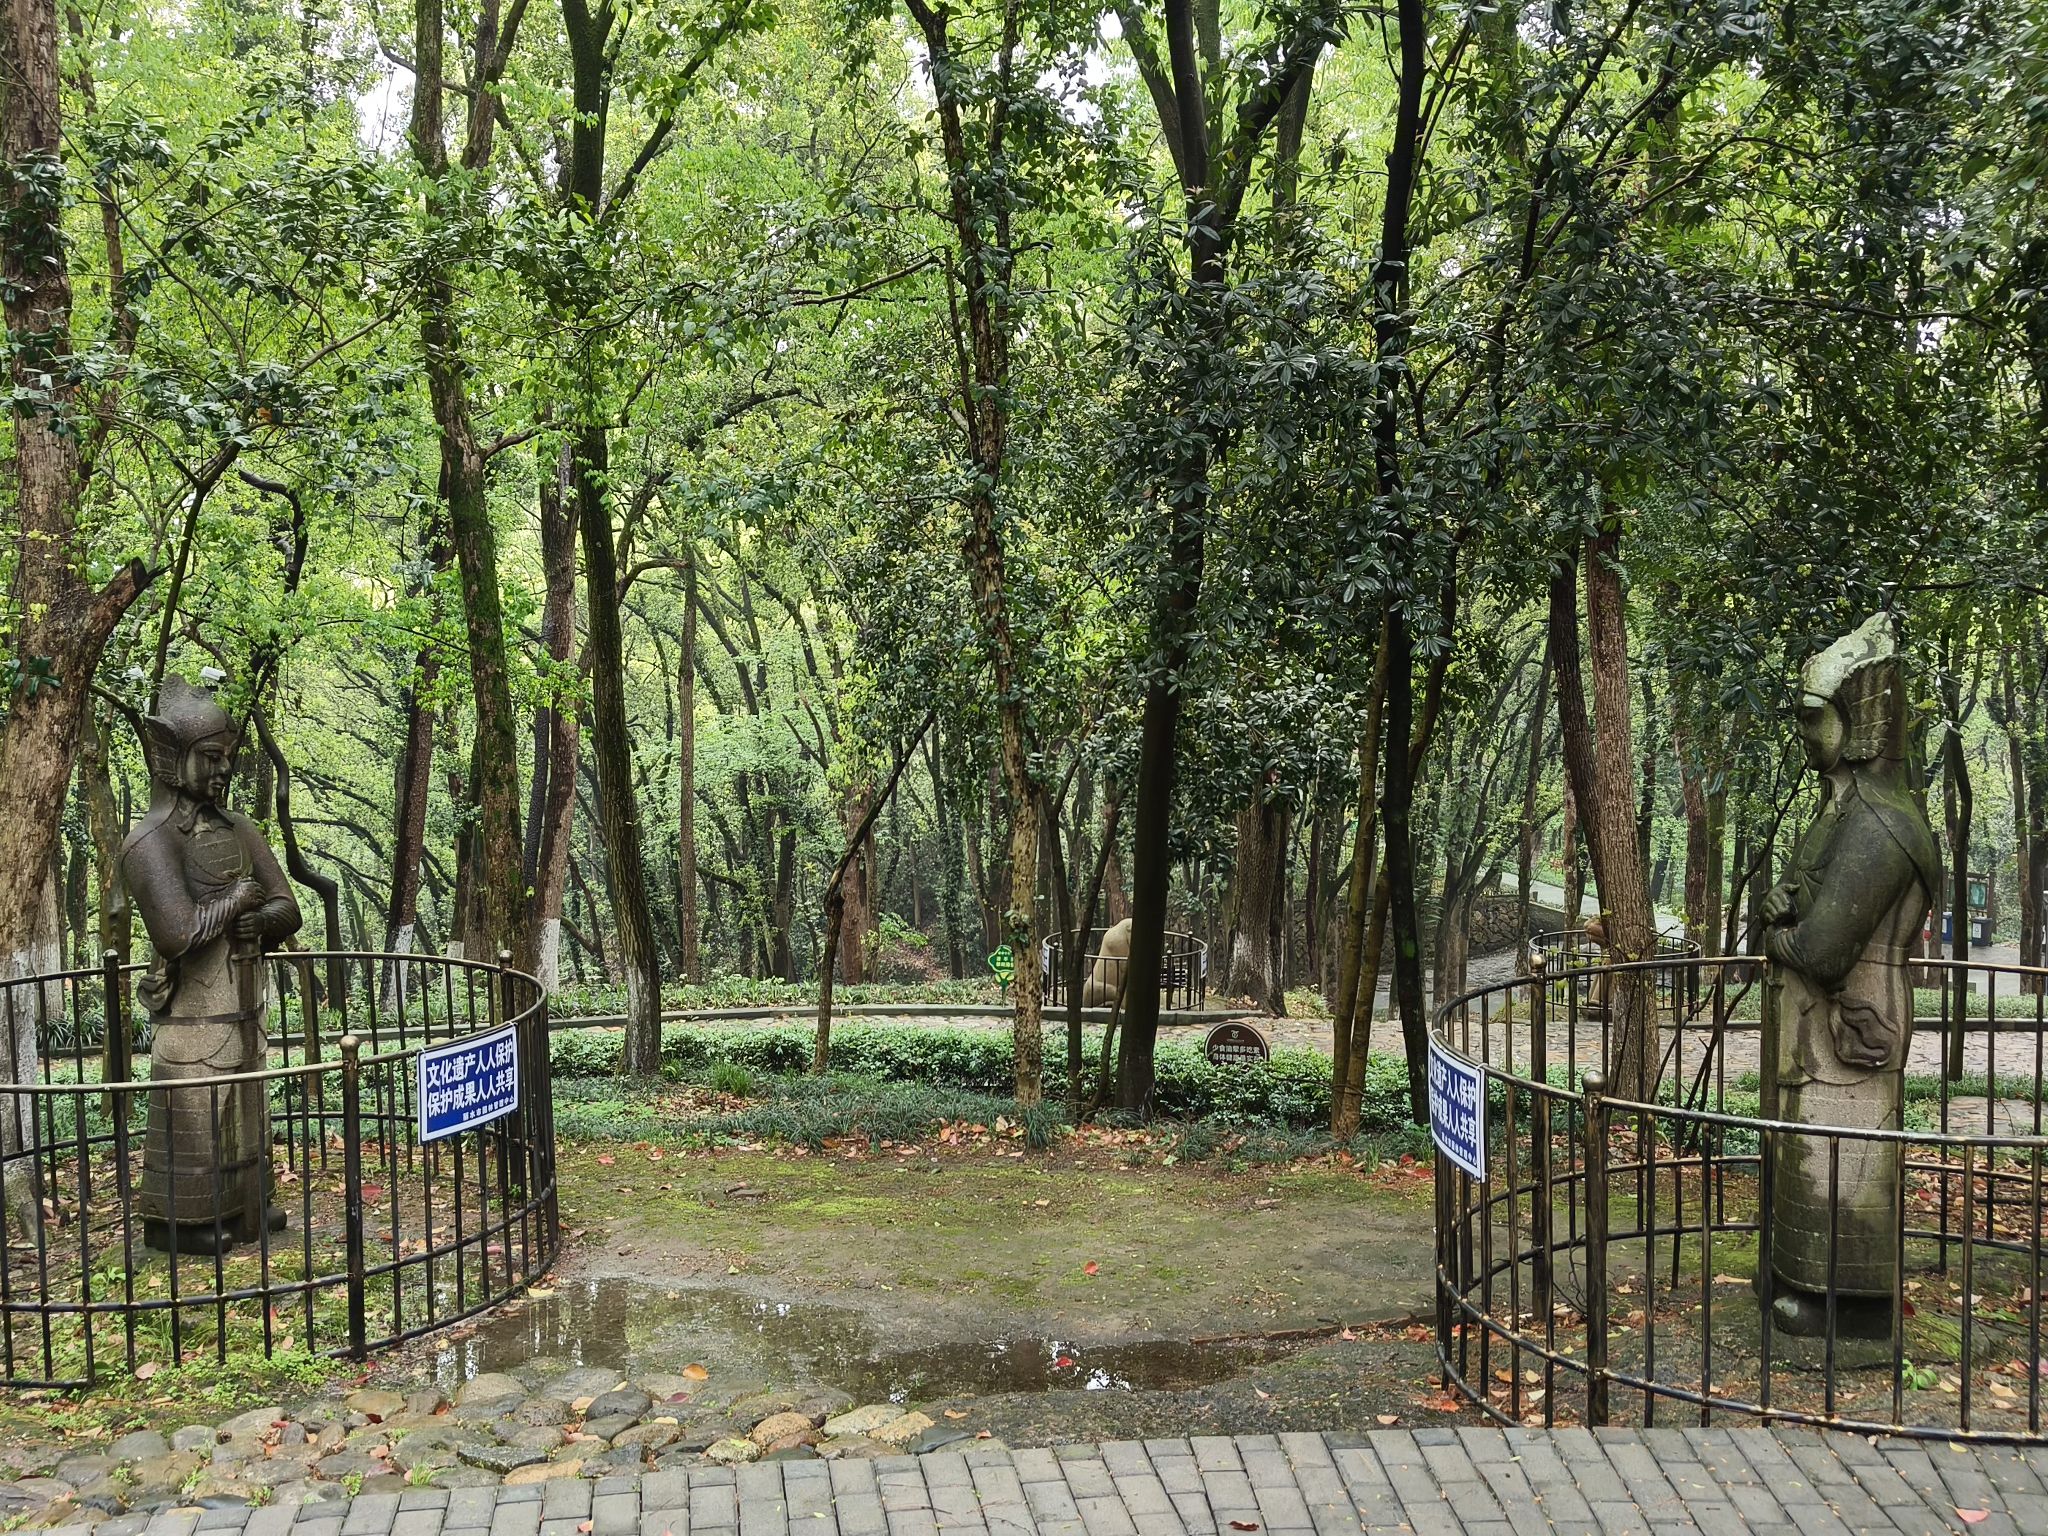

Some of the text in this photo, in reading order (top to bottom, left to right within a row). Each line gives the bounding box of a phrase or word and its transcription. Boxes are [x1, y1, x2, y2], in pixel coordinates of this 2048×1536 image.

[427, 1038, 513, 1089] 文化遗产人人保护
[427, 1066, 514, 1118] 保护成果人人共享
